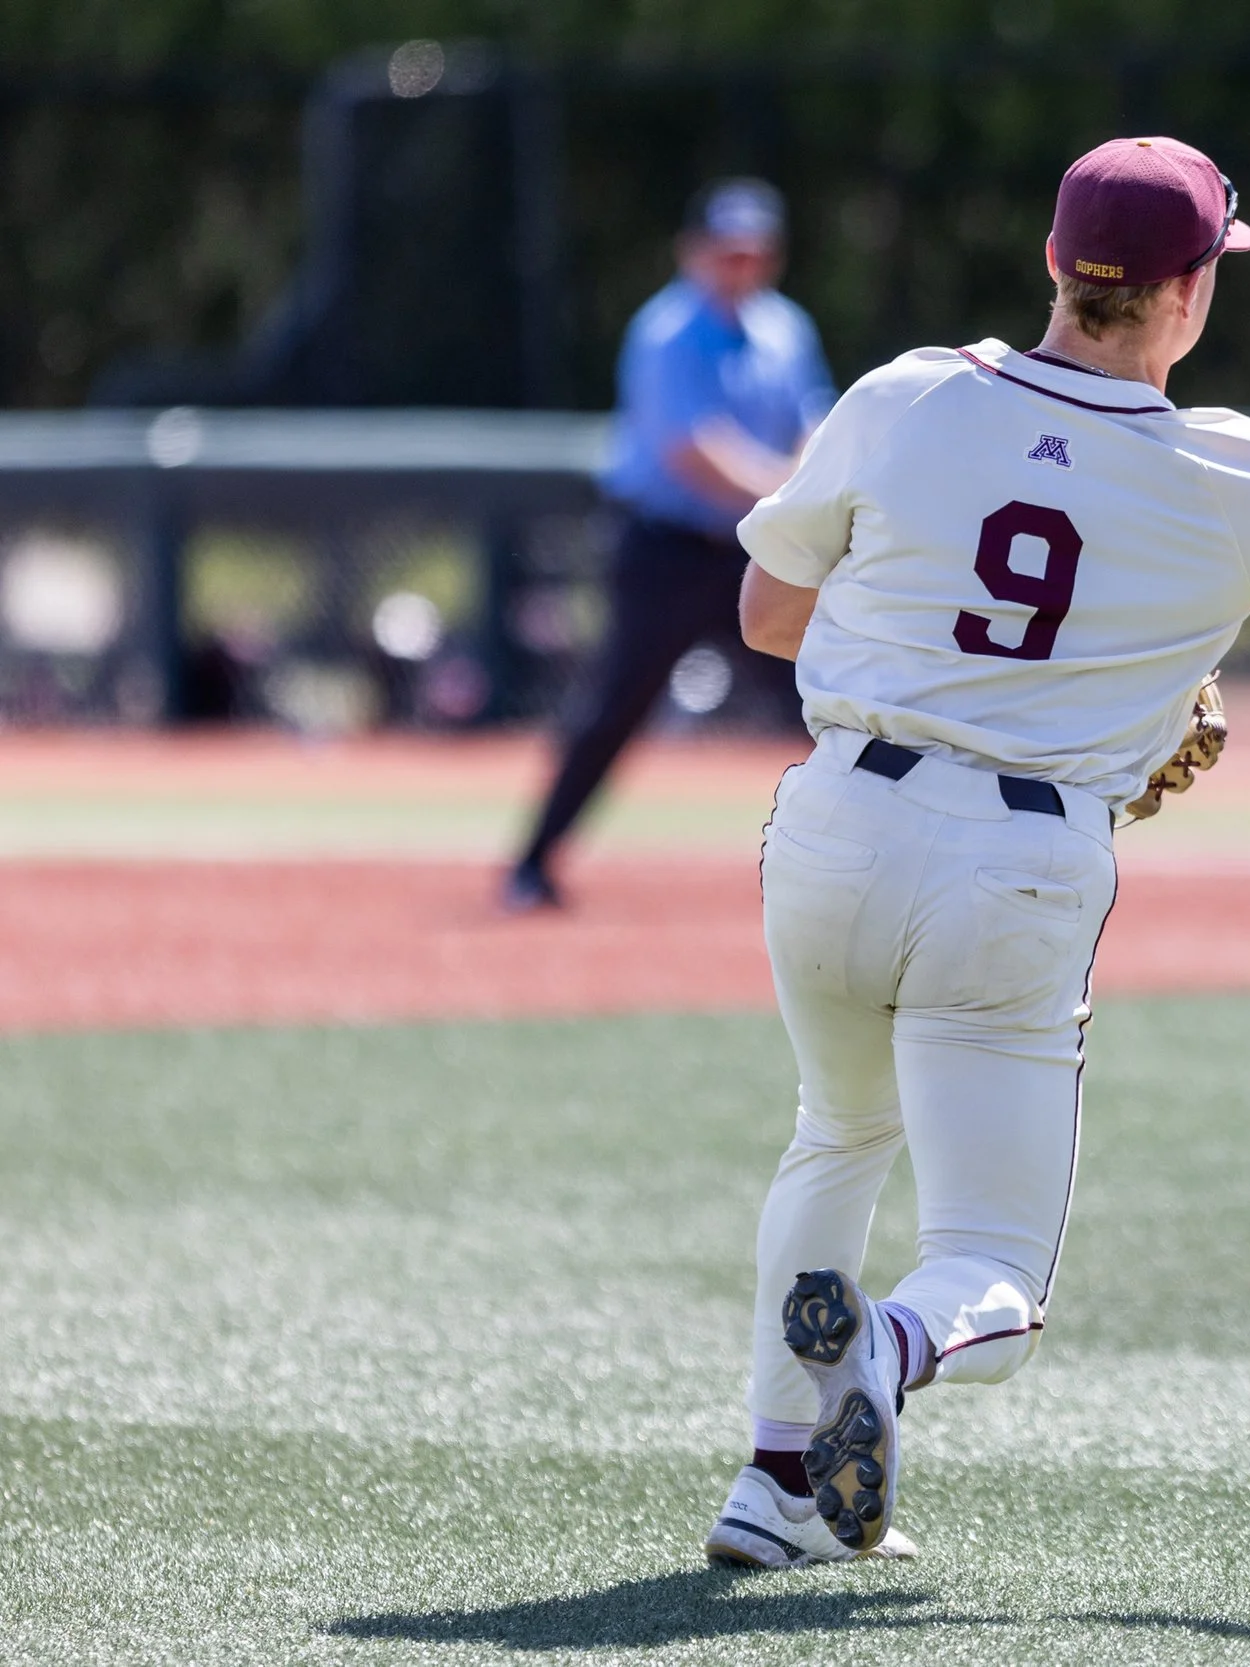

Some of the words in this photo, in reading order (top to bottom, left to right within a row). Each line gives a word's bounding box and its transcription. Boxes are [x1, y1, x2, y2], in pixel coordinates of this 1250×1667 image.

[1075, 259, 1124, 279] GOPHERS
[1027, 434, 1072, 468] M
[952, 500, 1084, 661] 9
